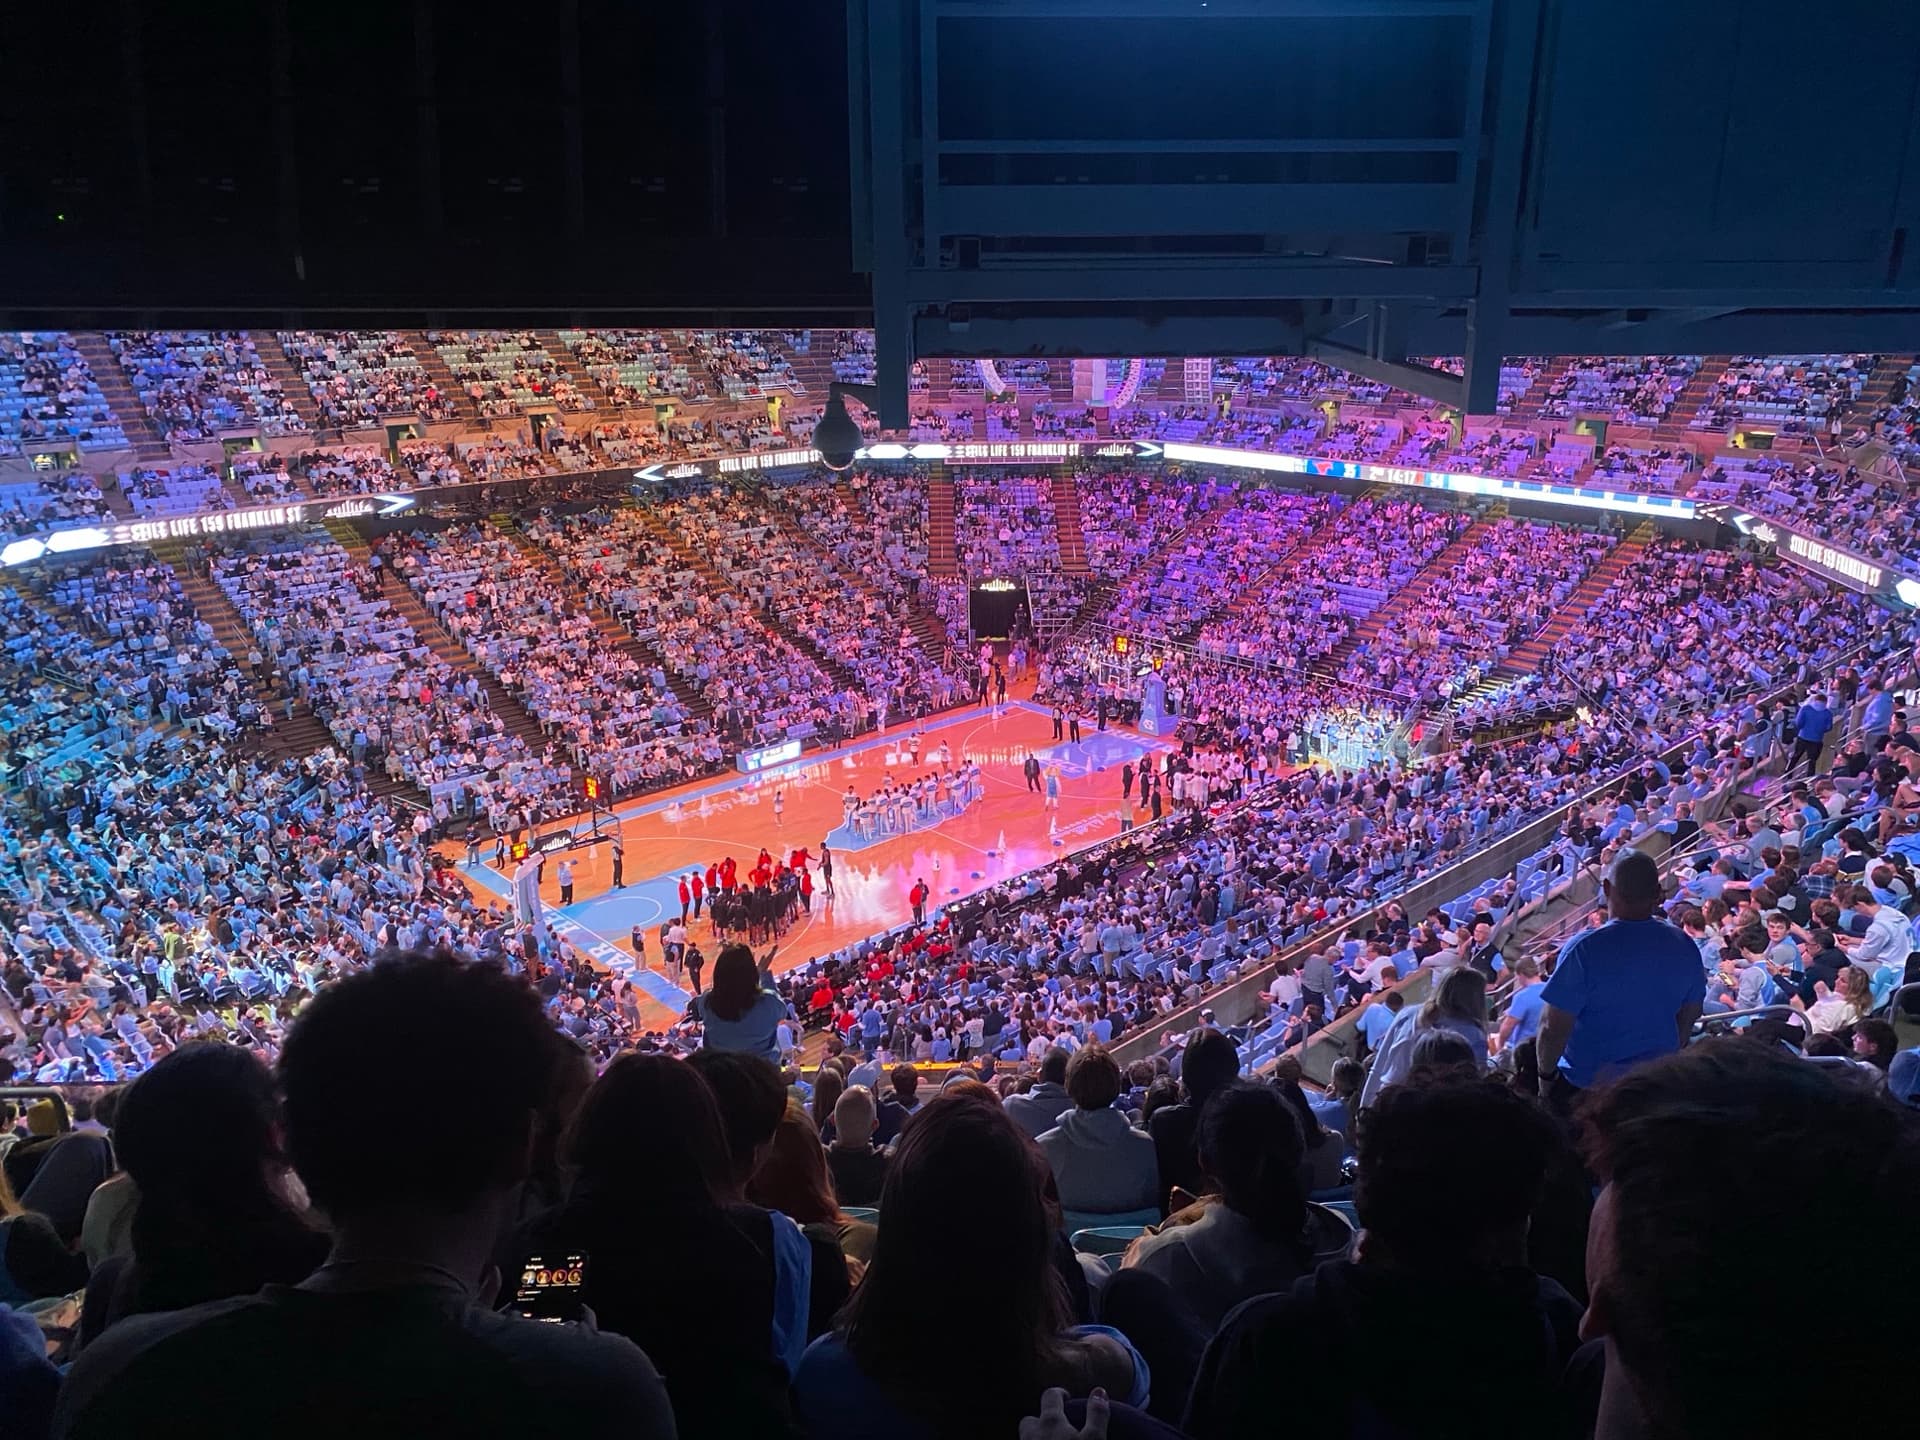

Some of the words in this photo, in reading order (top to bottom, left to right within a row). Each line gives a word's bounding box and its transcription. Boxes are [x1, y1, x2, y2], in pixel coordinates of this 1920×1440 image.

[990, 444, 1007, 456] LIFE
[1069, 444, 1079, 456] ST
[719, 458, 740, 472] STILL
[741, 456, 758, 470] LIFE
[169, 517, 198, 537] LIFE
[226, 508, 284, 530] FRANKLIN
[286, 506, 302, 524] ST
[1790, 534, 1808, 557] STILL
[1808, 541, 1824, 563] LIFE
[1869, 566, 1882, 588] ST
